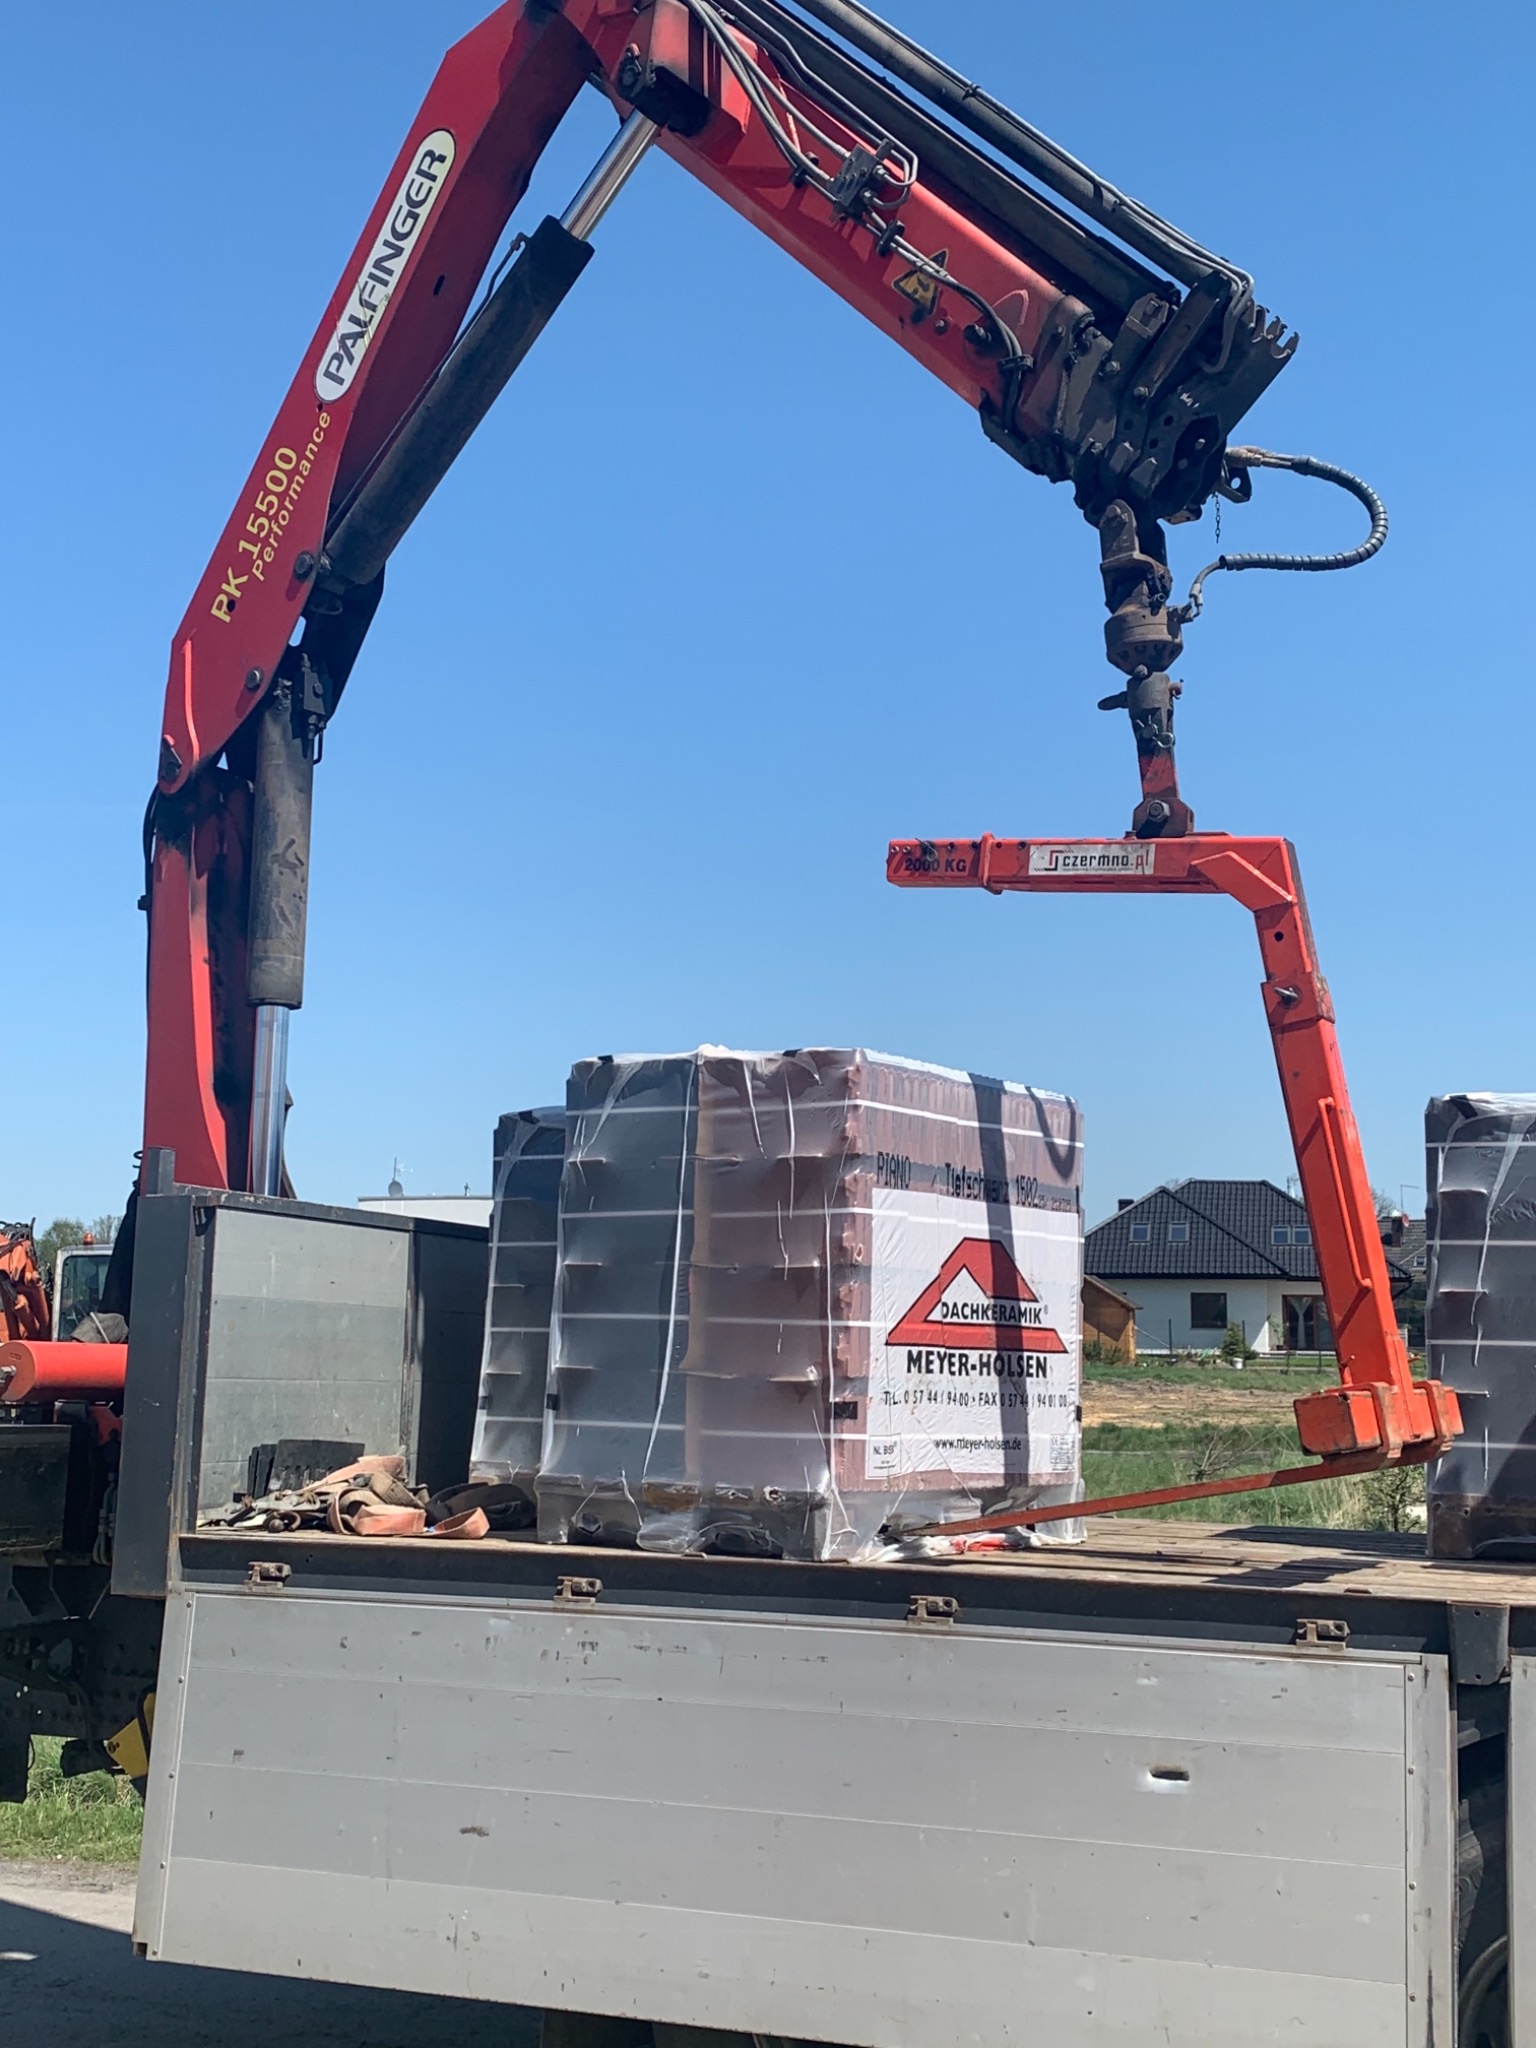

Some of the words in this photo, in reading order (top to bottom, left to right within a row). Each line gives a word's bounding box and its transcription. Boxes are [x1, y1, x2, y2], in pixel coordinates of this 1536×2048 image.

[323, 148, 447, 386] PALFINGER
[251, 412, 331, 582] Performance
[210, 566, 249, 623] PK
[238, 447, 298, 560] 15500
[904, 859, 940, 873] 2000
[945, 858, 967, 873] KG
[1062, 849, 1149, 871] czermno.pl
[876, 1151, 911, 1189] PIANO
[907, 1350, 1047, 1378] MEYER-HOLSEN
[978, 1392, 998, 1406] FAX
